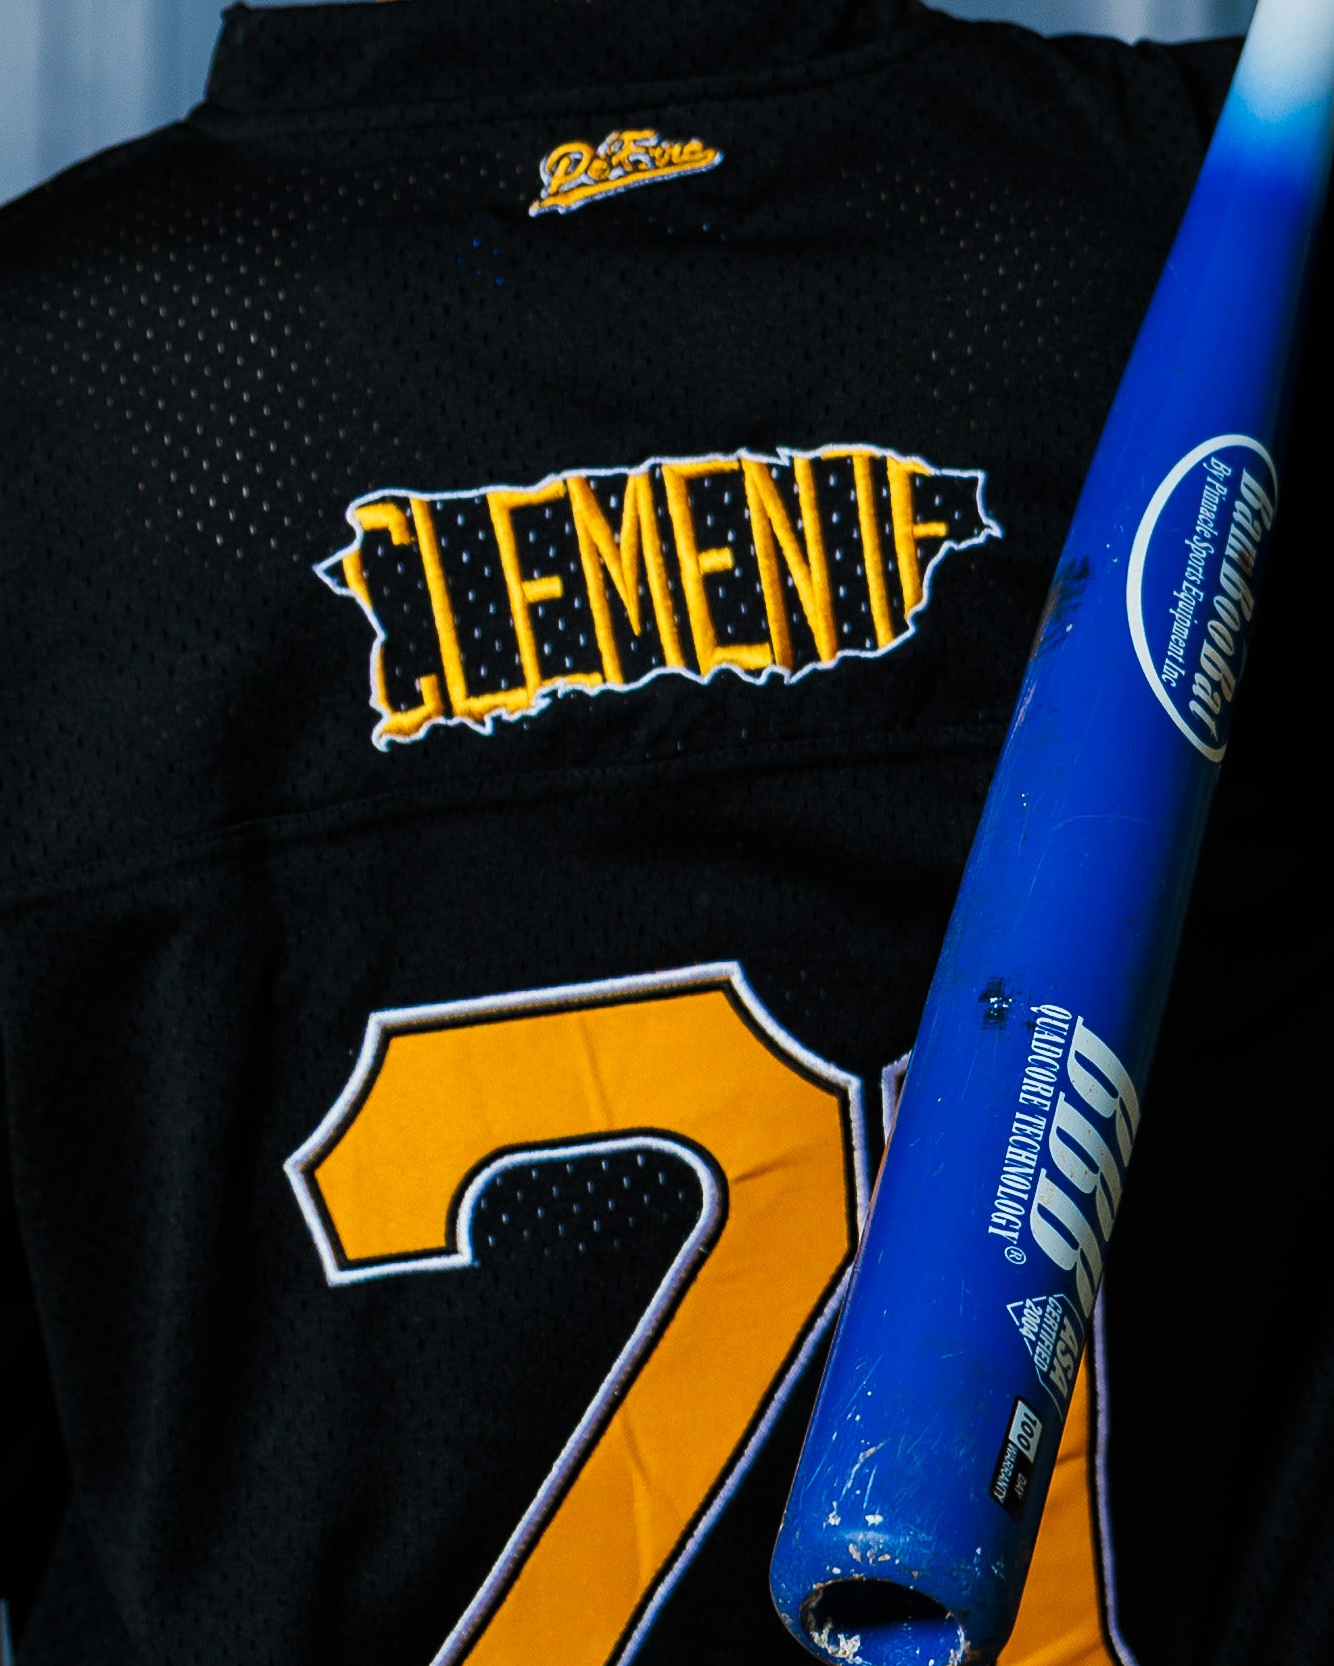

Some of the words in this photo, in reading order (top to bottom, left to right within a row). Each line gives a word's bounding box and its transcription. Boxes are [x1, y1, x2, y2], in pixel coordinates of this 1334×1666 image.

[1203, 457, 1232, 481] By
[1194, 477, 1228, 538] Pinnacle
[1185, 536, 1213, 584] Sports
[1167, 583, 1204, 662] Equipment
[1160, 658, 1185, 687] Inc
[1018, 1003, 1070, 1111] QUADCORE
[1018, 1298, 1041, 1341] 2004
[1033, 1297, 1062, 1372] CERTIFIED
[1049, 1315, 1079, 1398] ASA
[1015, 1412, 1037, 1450] 100
[994, 1443, 1018, 1503] WARRANTY
